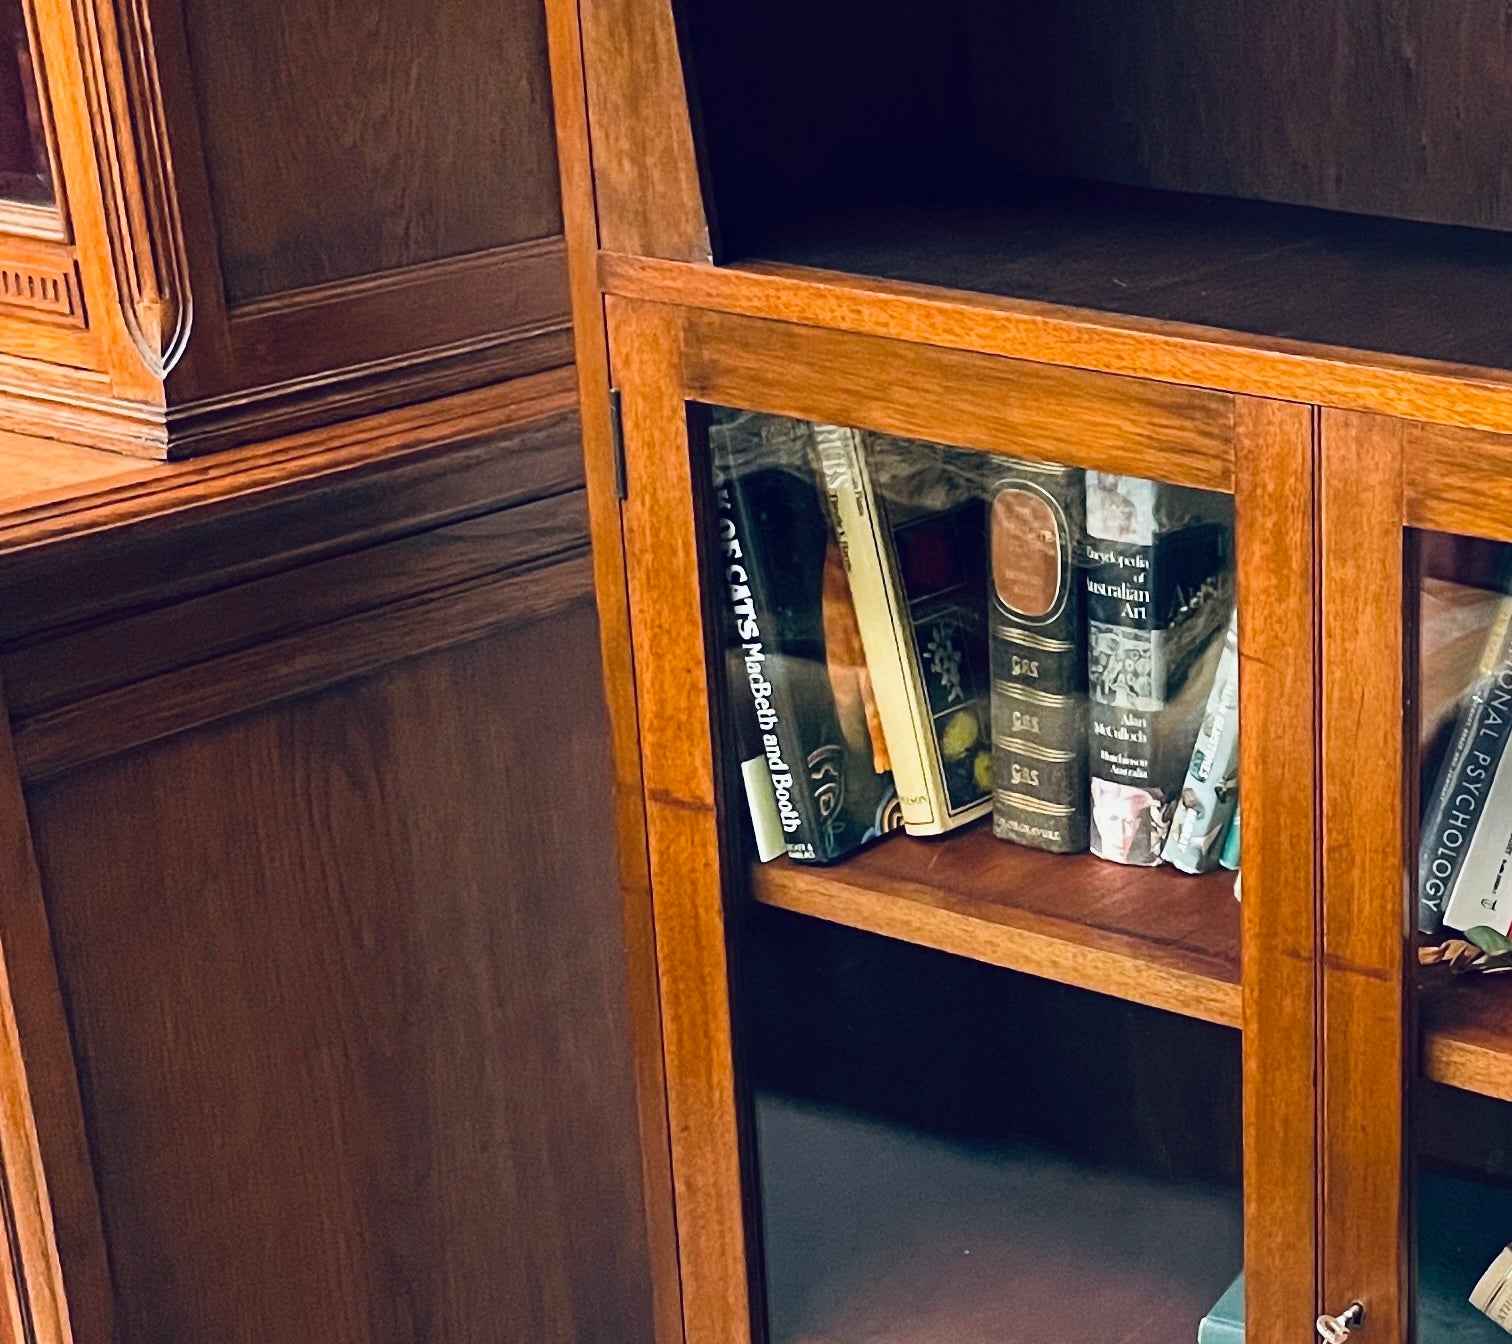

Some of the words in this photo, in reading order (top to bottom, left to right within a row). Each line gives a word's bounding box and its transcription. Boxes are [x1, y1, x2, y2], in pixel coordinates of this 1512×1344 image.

[1086, 545, 1150, 569] Encyclopedia
[1132, 572, 1146, 583] of
[726, 564, 760, 641] CATS
[1121, 602, 1147, 619] Art
[741, 642, 779, 730] MacBeth
[763, 733, 788, 772] and
[771, 773, 801, 833] Booth
[1421, 751, 1491, 912] PSYCHOLOGY
